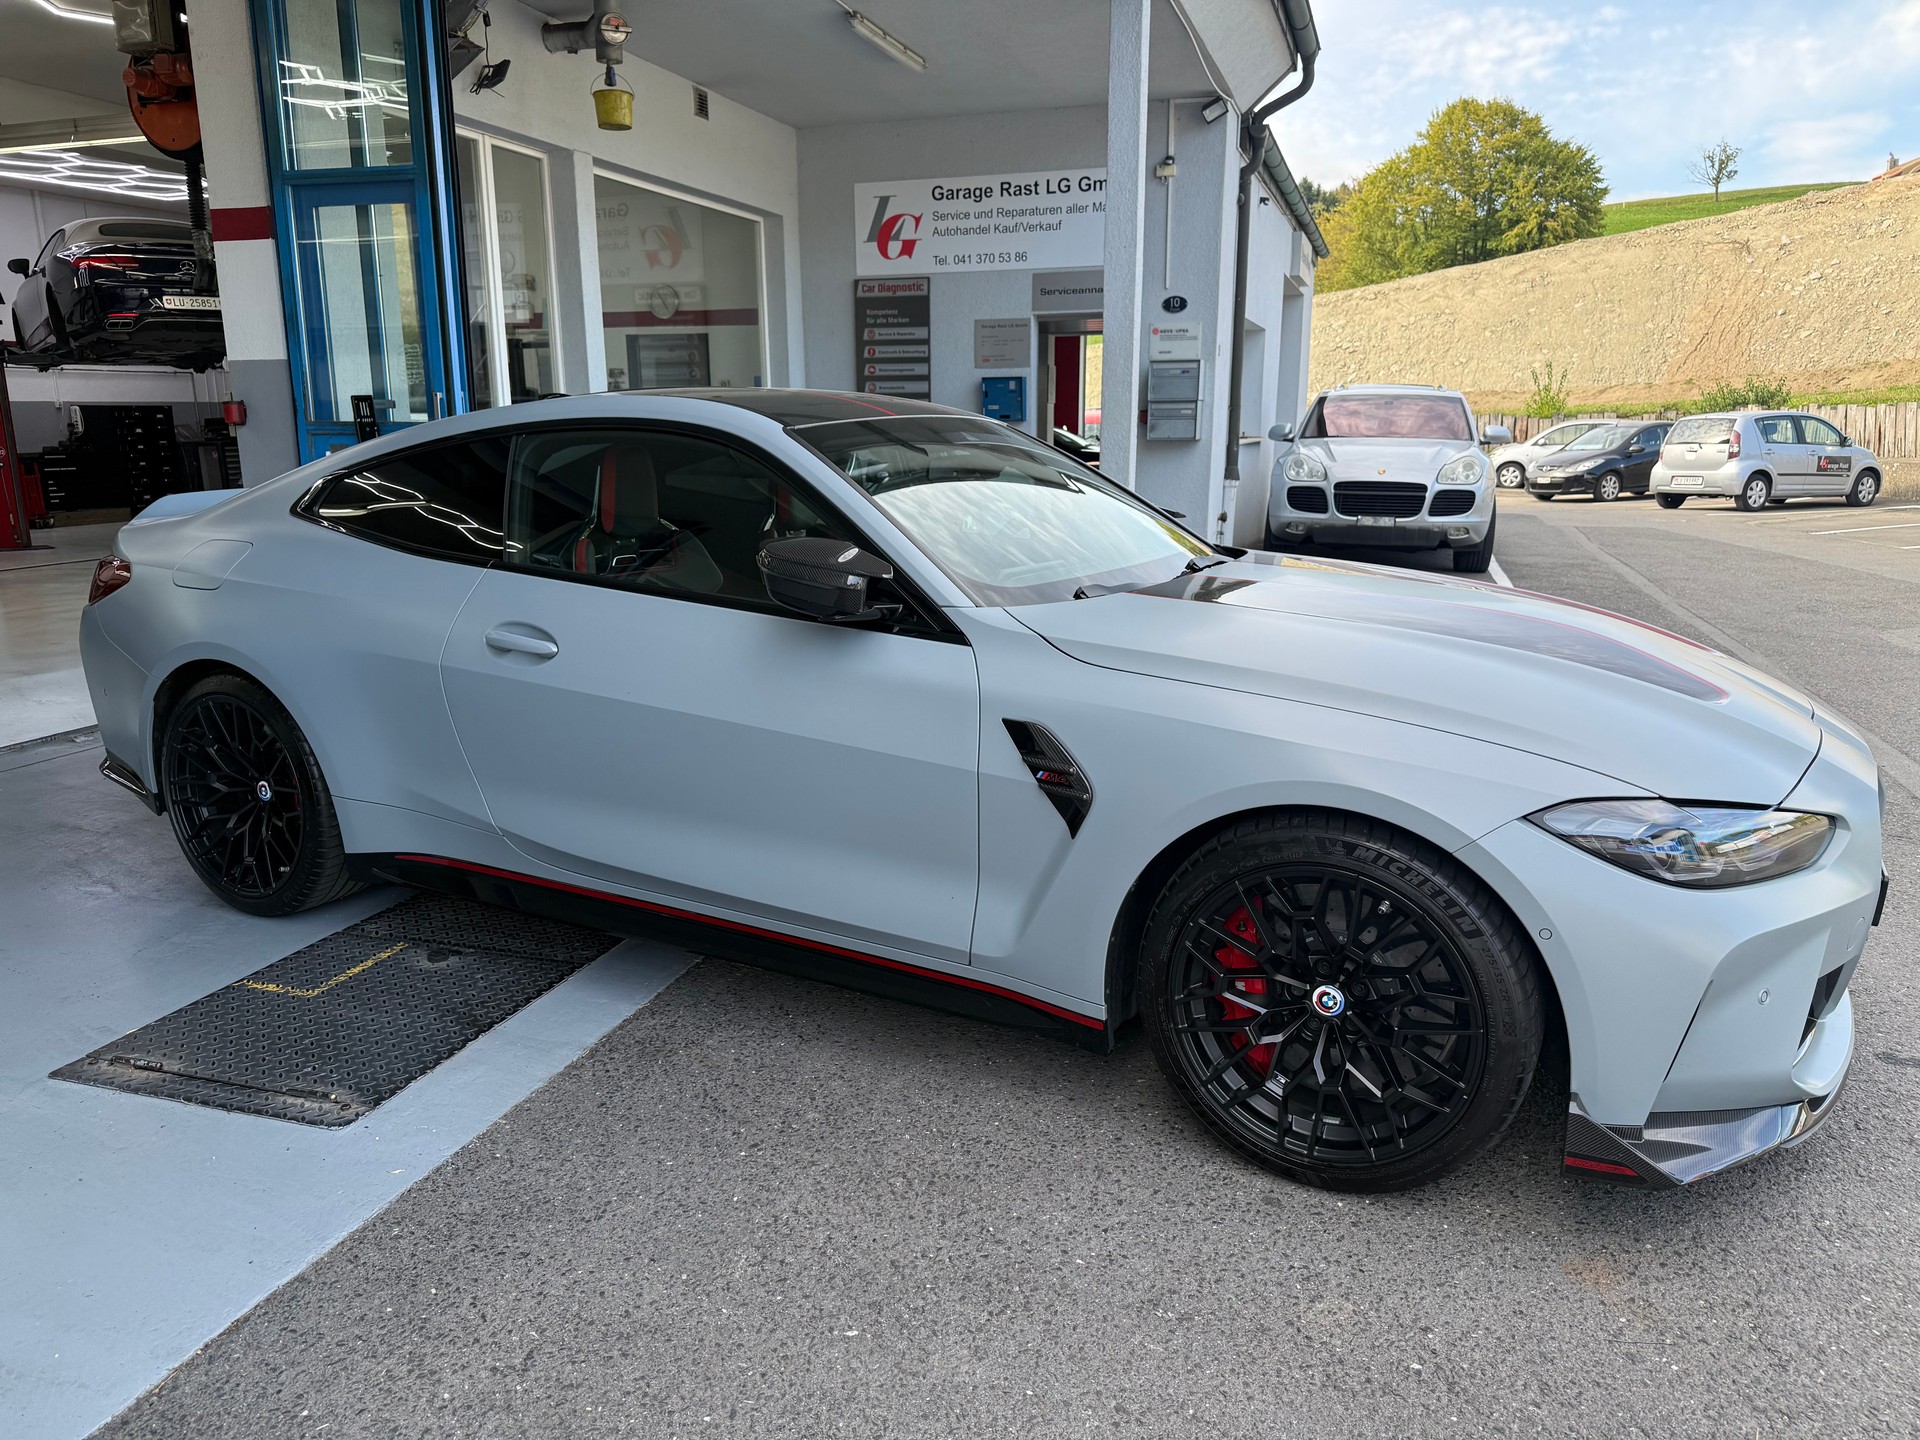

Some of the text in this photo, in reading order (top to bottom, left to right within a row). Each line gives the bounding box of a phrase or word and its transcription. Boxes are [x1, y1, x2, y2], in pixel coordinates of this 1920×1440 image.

[931, 185, 994, 203] Garage
[1000, 180, 1040, 198] Rast
[1046, 178, 1071, 194] LG
[932, 210, 971, 222] Service
[973, 208, 994, 220] und
[996, 205, 1063, 220] Reparaturen
[1065, 203, 1089, 215] aller
[932, 220, 1063, 238] Autohandel Kauf/Verkauf
[933, 251, 1028, 266] Tel. 041 370 53 86
[862, 281, 924, 295] Car Diagnostic
[1169, 297, 1181, 307] 10
[866, 309, 898, 317] Kompetenz
[1352, 845, 1477, 934] MICHELIN
